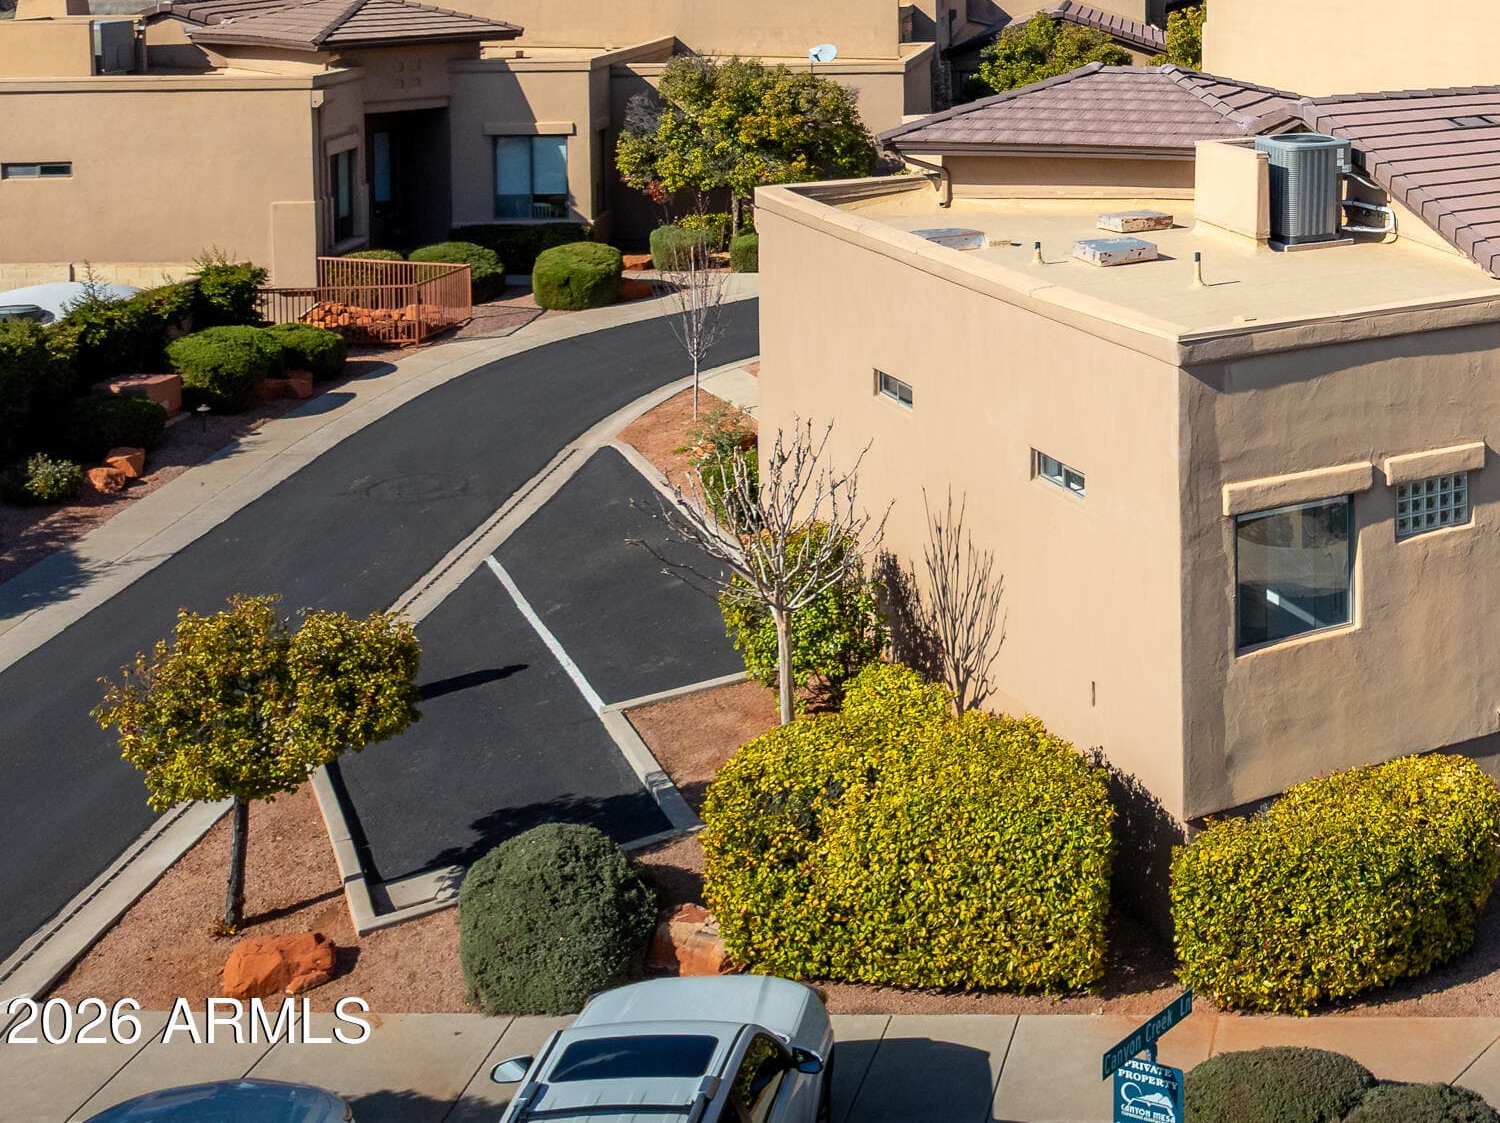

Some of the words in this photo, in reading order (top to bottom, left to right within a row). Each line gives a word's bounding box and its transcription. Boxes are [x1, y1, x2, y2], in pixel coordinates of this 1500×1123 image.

[1104, 1035, 1141, 1074] Canyon
[1145, 1009, 1172, 1042] Creek
[1180, 997, 1191, 1016] Ln
[1118, 1068, 1178, 1090] PROPERTY
[1121, 1103, 1151, 1118] CANYON
